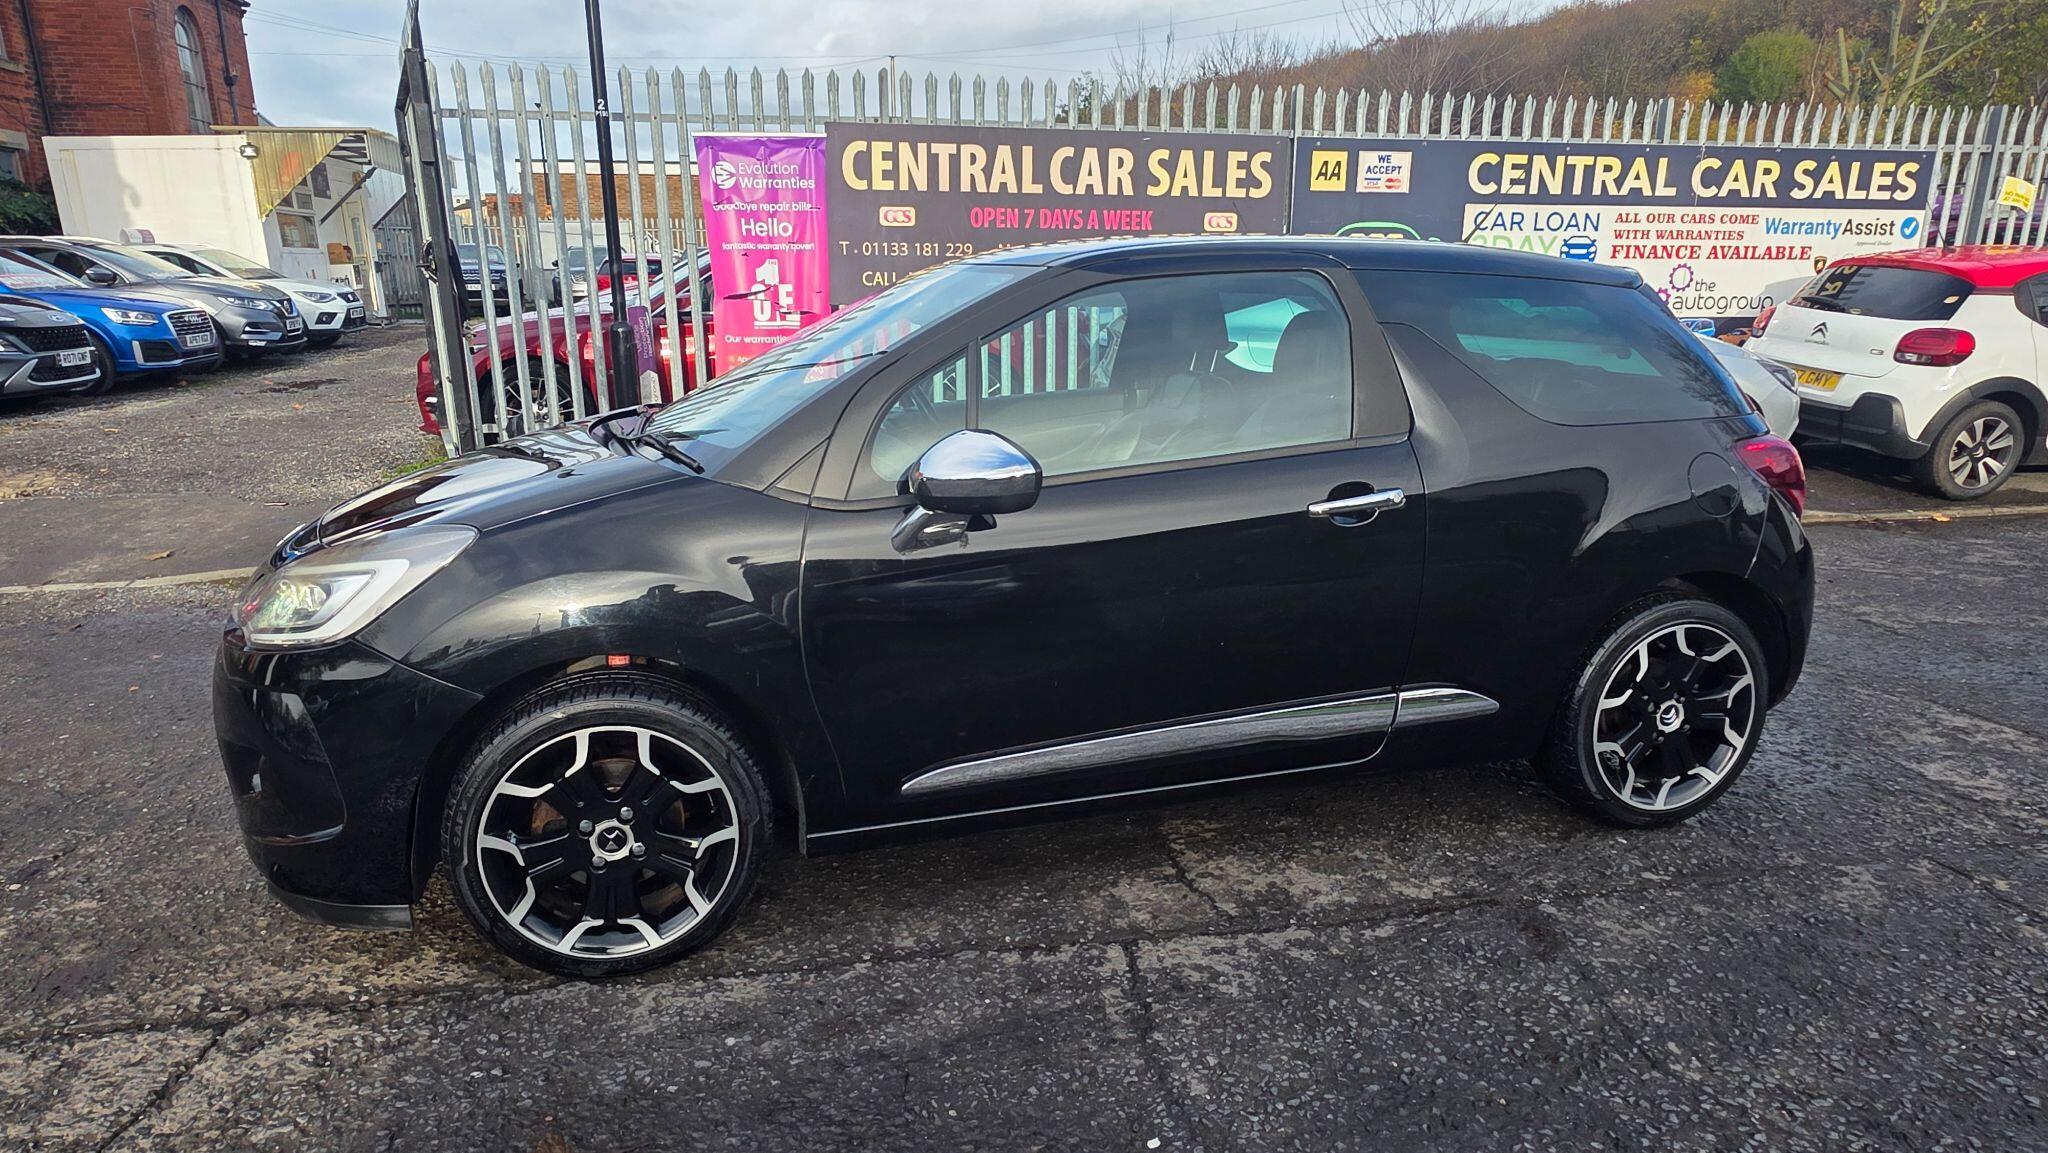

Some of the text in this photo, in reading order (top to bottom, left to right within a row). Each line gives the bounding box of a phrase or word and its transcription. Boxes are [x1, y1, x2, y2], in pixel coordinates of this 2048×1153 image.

[597, 98, 606, 110] 2
[1377, 154, 1392, 164] WE
[738, 162, 799, 175] Evolution
[841, 140, 1272, 199] CENTRAL CAR SALES
[1315, 160, 1341, 181] AA
[1365, 165, 1402, 175] ACCEPT
[738, 176, 816, 189] Warranties
[1467, 152, 1920, 201] CENTRAL CAR SALES
[760, 202, 790, 214] repair
[969, 207, 1153, 231] OPEN 7 DAYS A WEEK
[1474, 211, 1601, 232] CAR LOAN
[1614, 212, 1760, 225] ALL OUR CARS COME
[740, 217, 793, 237] Hello
[1613, 229, 1745, 241] WITH WARRANTIES
[722, 242, 756, 250] fantastic
[757, 243, 790, 252] warranty
[862, 242, 909, 256] 01133
[914, 243, 939, 257] 181
[945, 243, 973, 257] 229
[1609, 245, 1814, 261] FINANCE AVAILABLE
[1694, 278, 1717, 292] the
[1672, 293, 1774, 315] autogroup
[724, 334, 789, 344] Our warrantie
